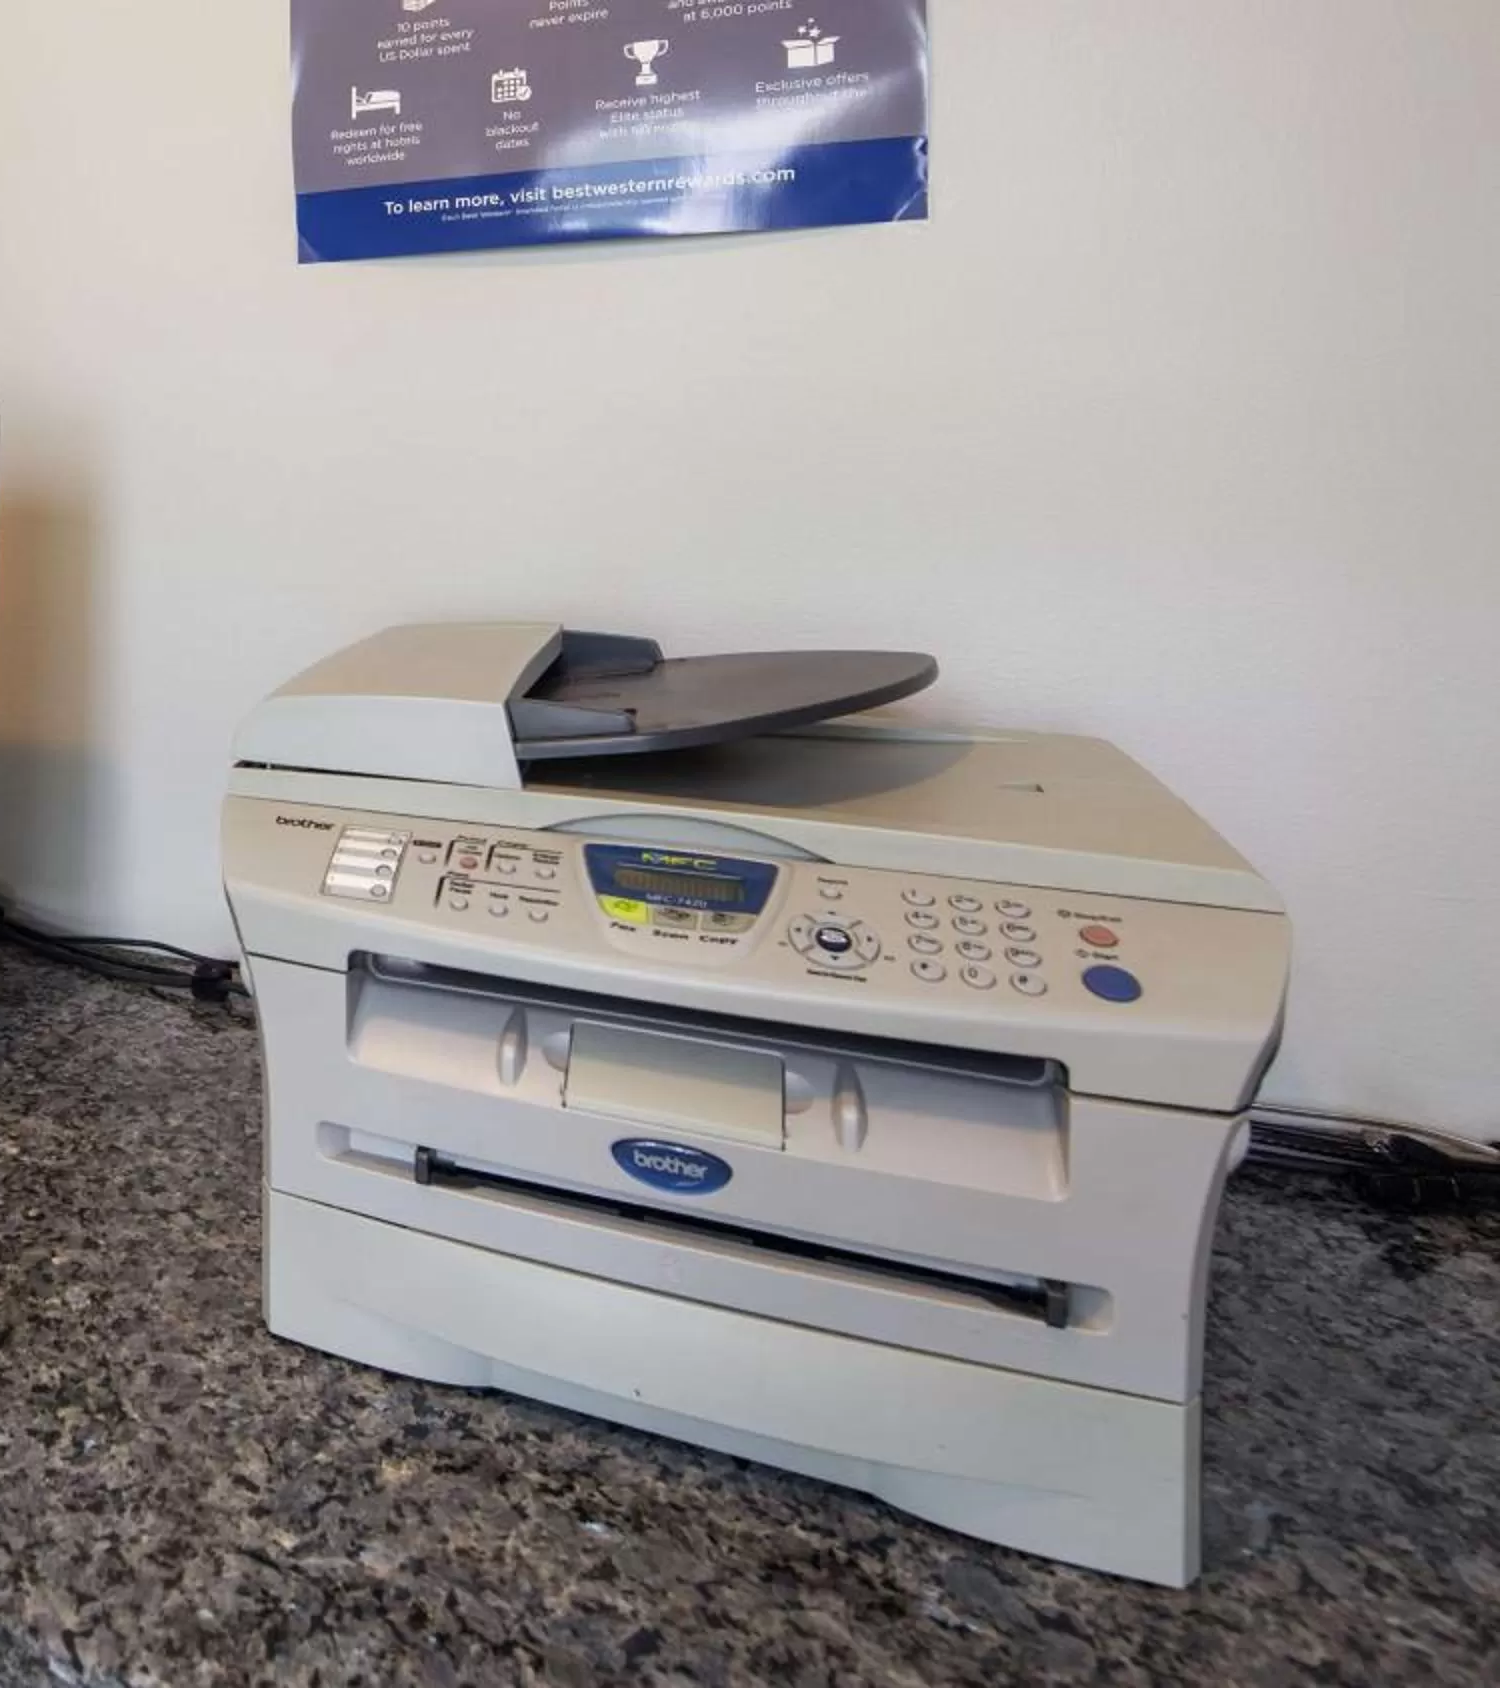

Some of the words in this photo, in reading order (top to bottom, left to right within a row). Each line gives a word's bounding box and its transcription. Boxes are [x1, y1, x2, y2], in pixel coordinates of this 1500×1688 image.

[529, 15, 565, 29] never
[567, 8, 609, 24] expire
[700, 3, 744, 20] 6,000
[747, 0, 792, 16] points
[397, 22, 411, 33] 10
[413, 18, 450, 33] points
[420, 33, 438, 44] for
[439, 28, 476, 43] every
[399, 47, 434, 61] Dollar
[436, 41, 471, 57] spent
[755, 77, 822, 93] Exclusive
[825, 71, 869, 85] offers
[595, 97, 647, 111] Receive
[650, 89, 700, 106] highest
[503, 111, 521, 121] No
[610, 111, 641, 124] Elite
[330, 128, 377, 140] Redeem
[379, 124, 397, 136] for
[399, 121, 423, 134] free
[485, 121, 539, 137] blackout
[333, 141, 368, 155] nights
[370, 139, 382, 150] at
[495, 138, 531, 150] dates
[345, 150, 405, 166] worldwide
[384, 200, 404, 215] To
[409, 198, 449, 213] learn
[455, 192, 504, 208] more,
[510, 187, 547, 203] visit
[552, 167, 796, 201] bestwesternrewards.com
[275, 815, 336, 831] brother
[641, 851, 717, 871] MFC
[633, 1150, 709, 1181] brother
